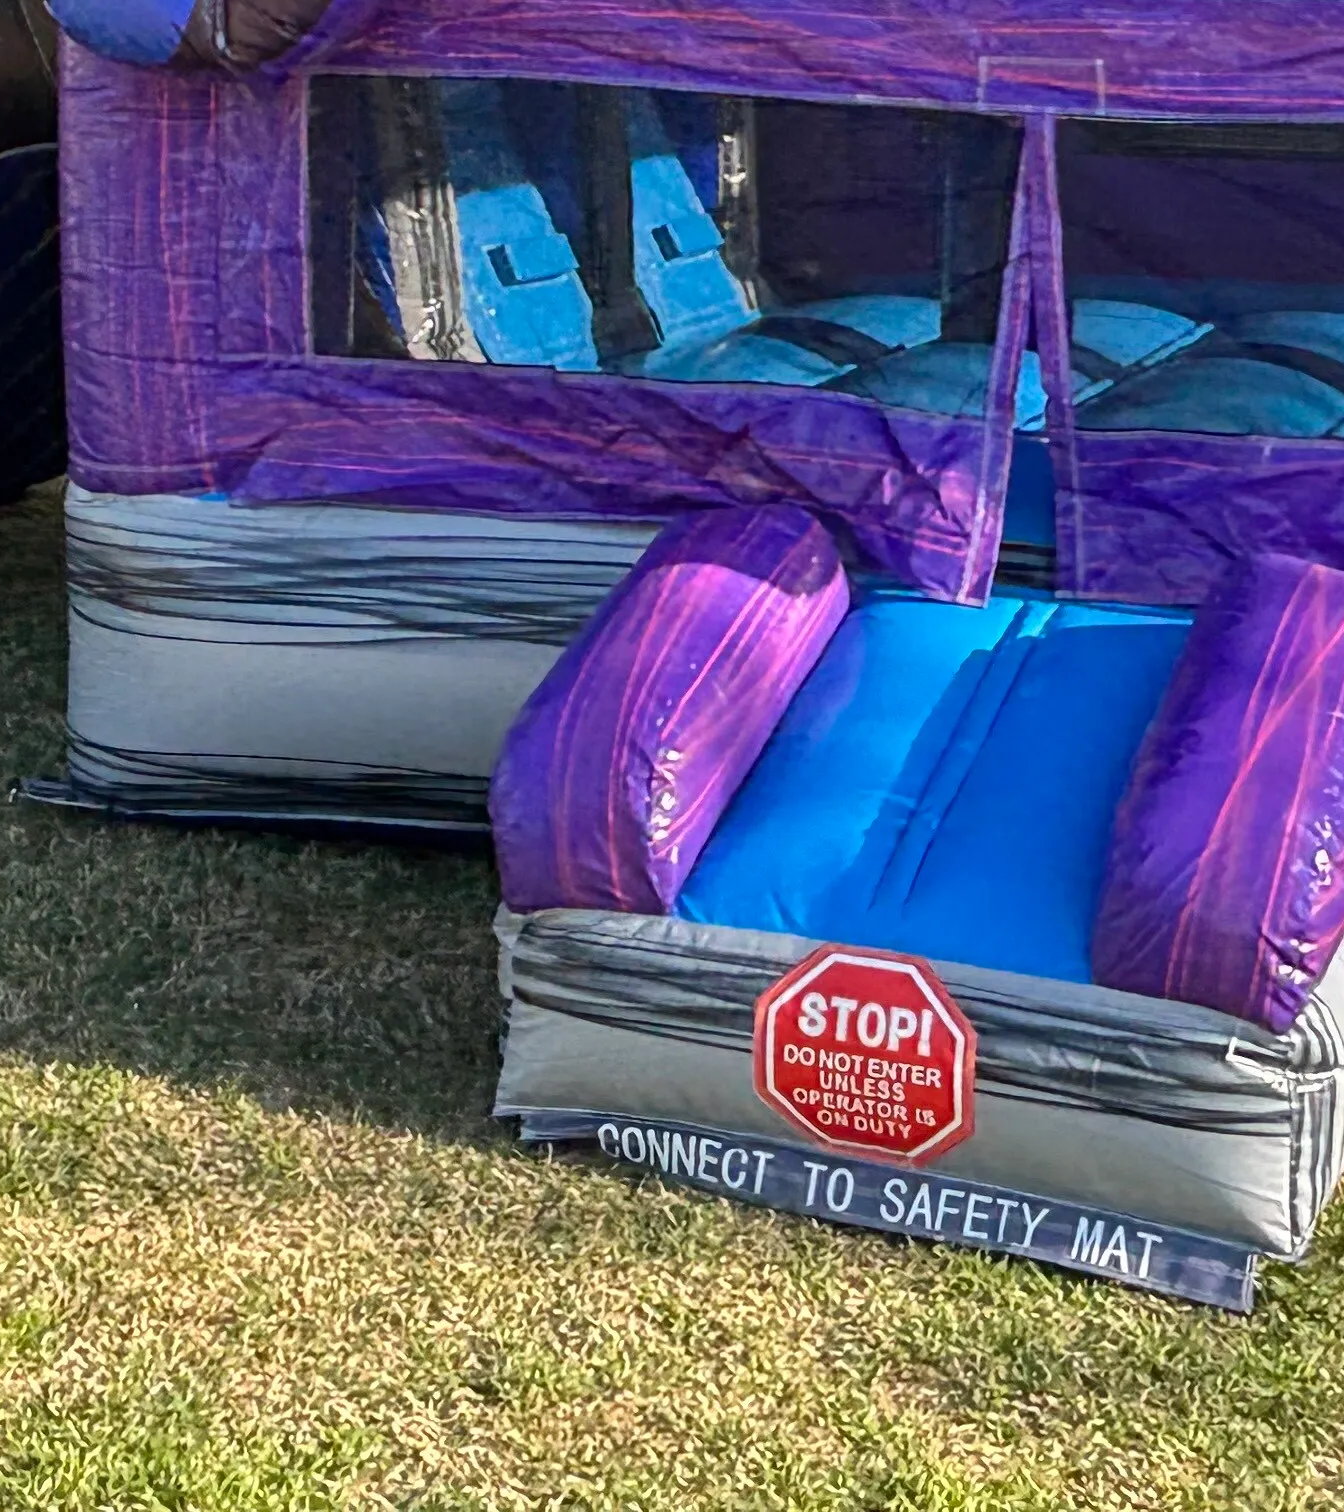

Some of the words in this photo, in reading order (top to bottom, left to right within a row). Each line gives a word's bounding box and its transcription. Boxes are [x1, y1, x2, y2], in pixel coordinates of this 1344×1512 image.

[797, 991, 934, 1057] STOP!
[783, 1043, 816, 1067] DO
[818, 1048, 865, 1075] NOT
[867, 1057, 942, 1088] ENTER
[792, 1087, 908, 1122] OPERATOR
[818, 1070, 906, 1102] UNLESS
[816, 1109, 849, 1127] ON
[853, 1115, 912, 1139] DUTY
[596, 1122, 775, 1195] CONNECT
[802, 1160, 855, 1213] TO
[879, 1177, 1051, 1249] SAFETY
[1069, 1215, 1164, 1279] MAT
